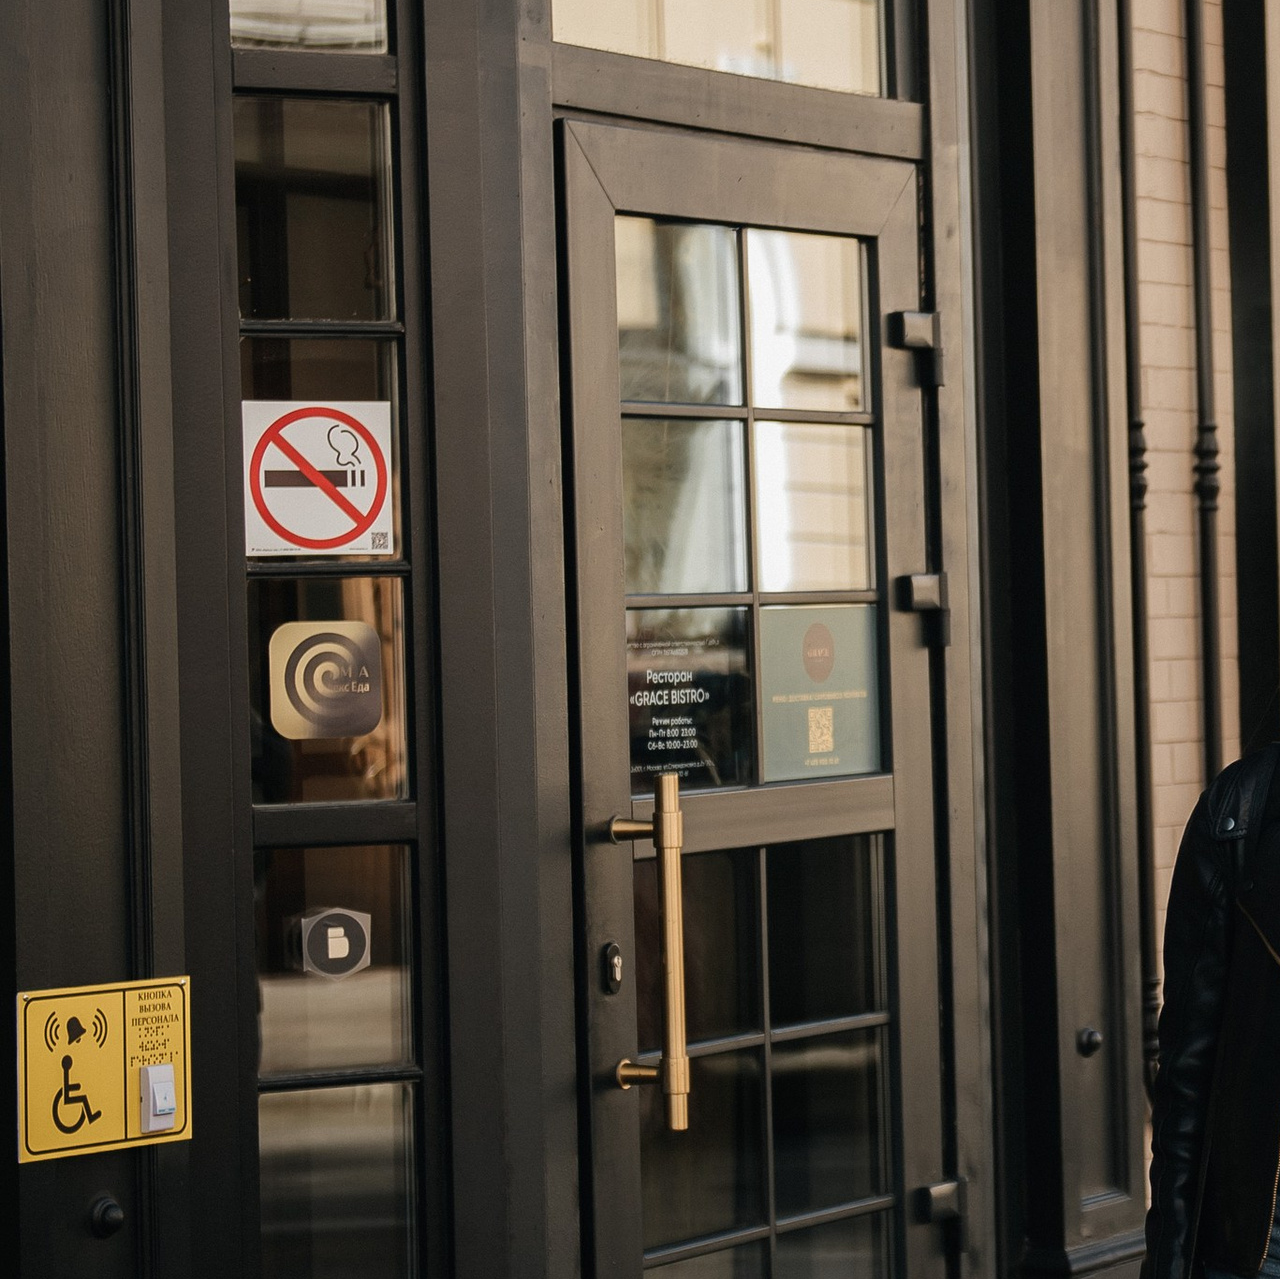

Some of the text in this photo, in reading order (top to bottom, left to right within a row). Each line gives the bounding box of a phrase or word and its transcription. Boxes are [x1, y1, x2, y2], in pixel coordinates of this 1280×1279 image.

[646, 669, 693, 686] Ресторан
[351, 681, 370, 693] Еда
[630, 688, 710, 706] «GRACE BISTRO»
[138, 990, 172, 1001] КНОПКА
[139, 1002, 171, 1013] ВЫЗОВА
[131, 1014, 179, 1027] ПЕРСОНАЛА
